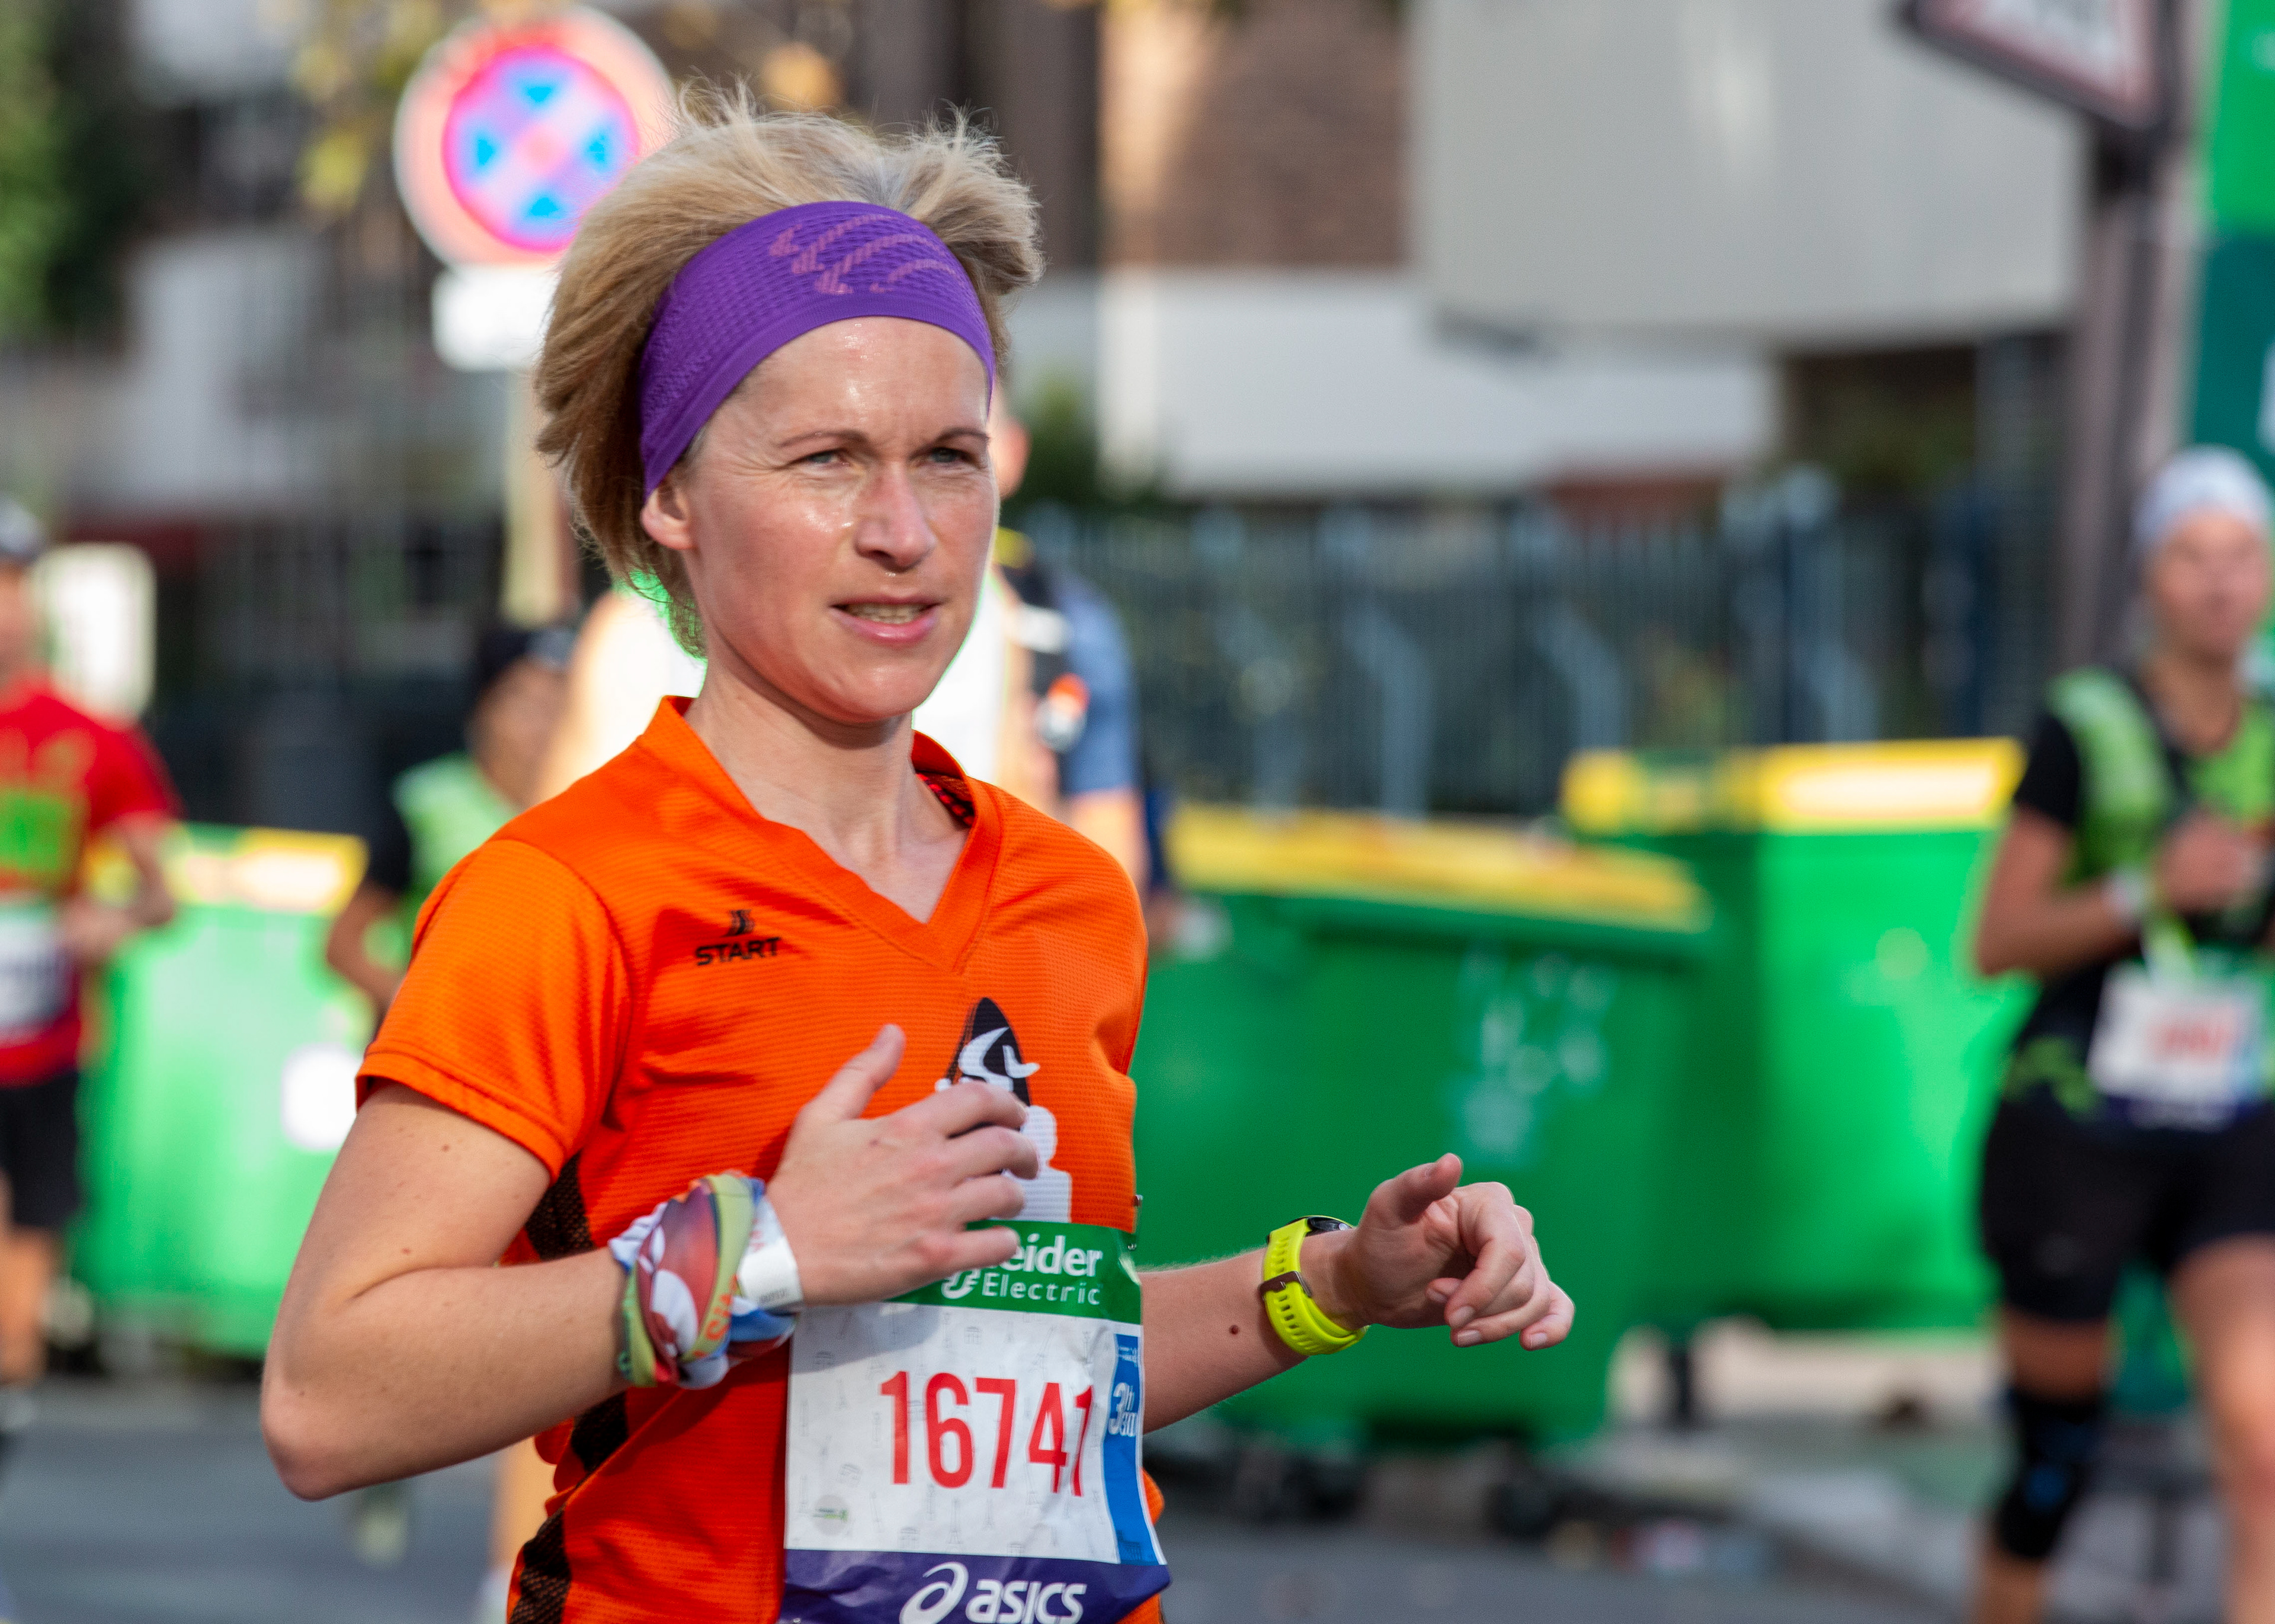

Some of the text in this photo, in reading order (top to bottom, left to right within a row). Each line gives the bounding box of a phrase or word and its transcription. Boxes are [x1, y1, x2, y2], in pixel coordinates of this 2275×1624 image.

[696, 936, 782, 966] START
[998, 1233, 1103, 1277] eider
[982, 1272, 1101, 1305] Electric
[879, 1371, 1094, 1497] 16741
